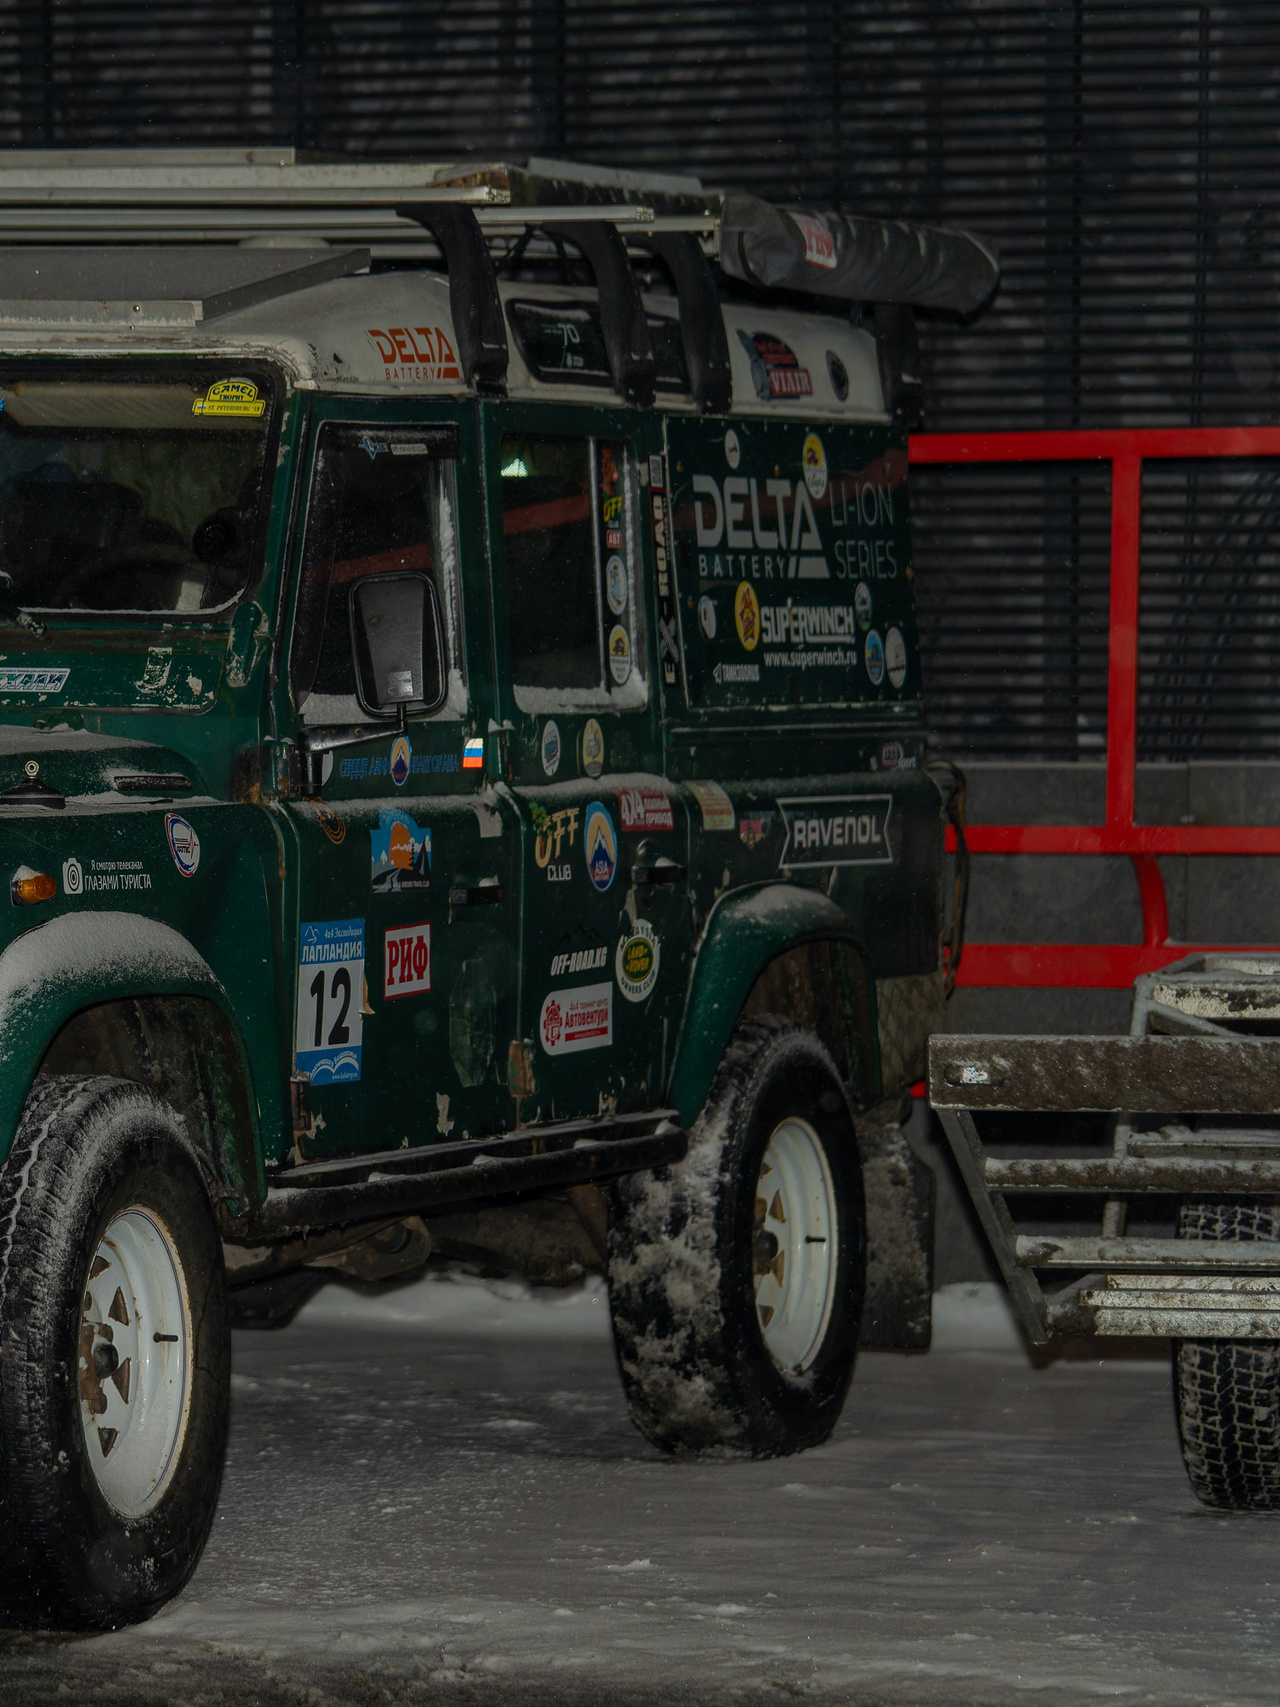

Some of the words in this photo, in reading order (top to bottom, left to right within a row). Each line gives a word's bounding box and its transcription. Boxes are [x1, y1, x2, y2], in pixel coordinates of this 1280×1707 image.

[366, 327, 457, 363] DELTA
[384, 368, 435, 381] BATTERY
[213, 385, 254, 397] CAMEL
[692, 474, 822, 551] DELTA
[697, 554, 786, 579] BATTERY
[834, 539, 897, 579] SERIES
[761, 604, 856, 643] SUPERWINCH
[764, 649, 858, 671] www.superwinch.ru
[793, 815, 881, 849] RAVENOL
[90, 860, 97, 870] Я
[547, 864, 572, 881] CLUB
[85, 875, 119, 891] ГЛАЗАМИ
[119, 873, 152, 890] ТУРИСТА
[301, 940, 363, 962] ЛАПЛАНДИЯ
[387, 935, 428, 985] РИФ
[310, 967, 351, 1047] 12
[564, 1008, 608, 1028] Автовентури
